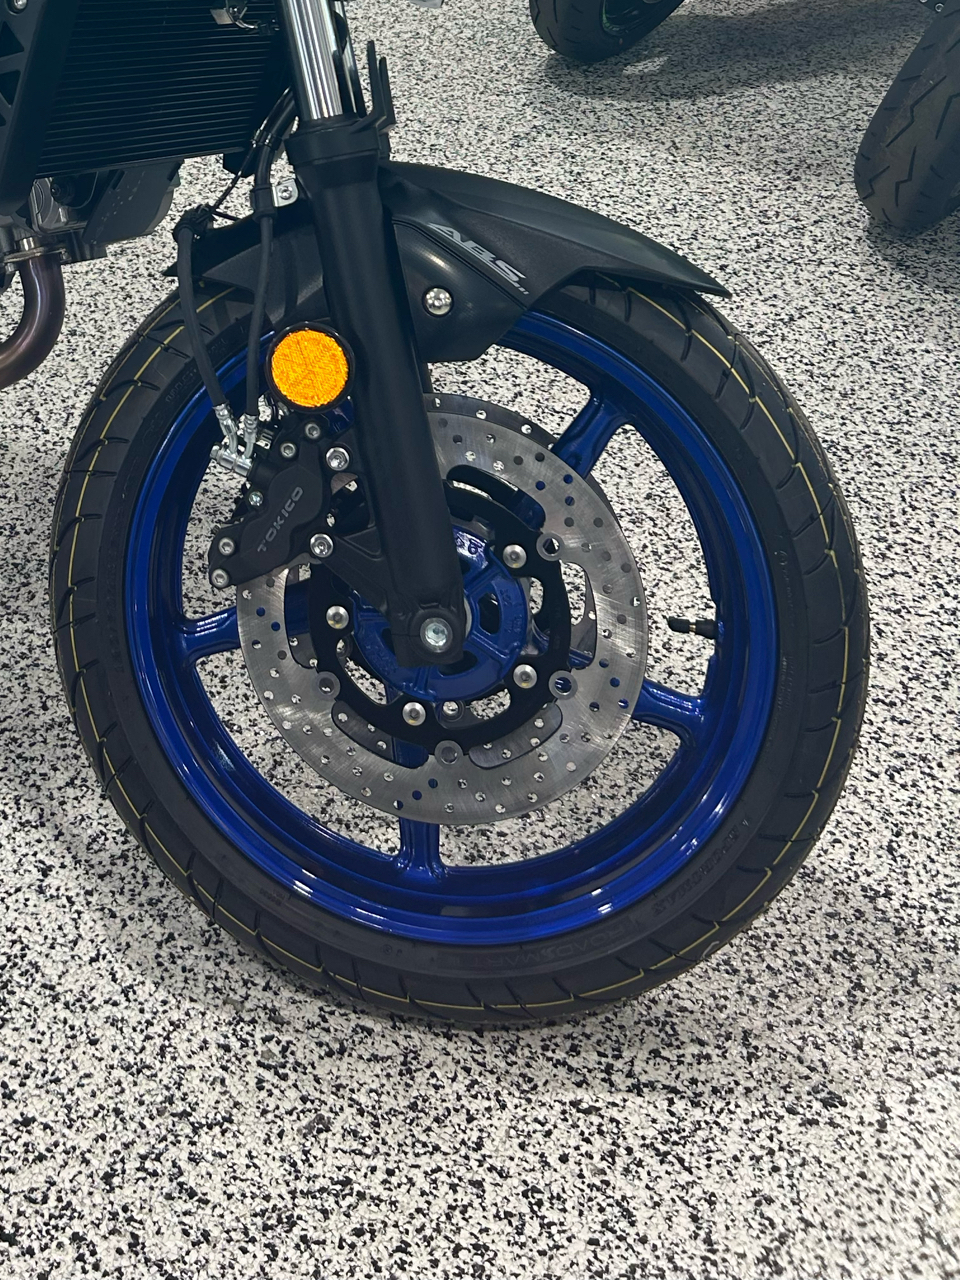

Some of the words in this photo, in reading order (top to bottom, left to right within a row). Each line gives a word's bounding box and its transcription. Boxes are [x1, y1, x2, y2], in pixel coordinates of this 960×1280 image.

[426, 222, 527, 280] ABS
[257, 486, 304, 552] TOKICO
[472, 924, 624, 967] ROADSMART
